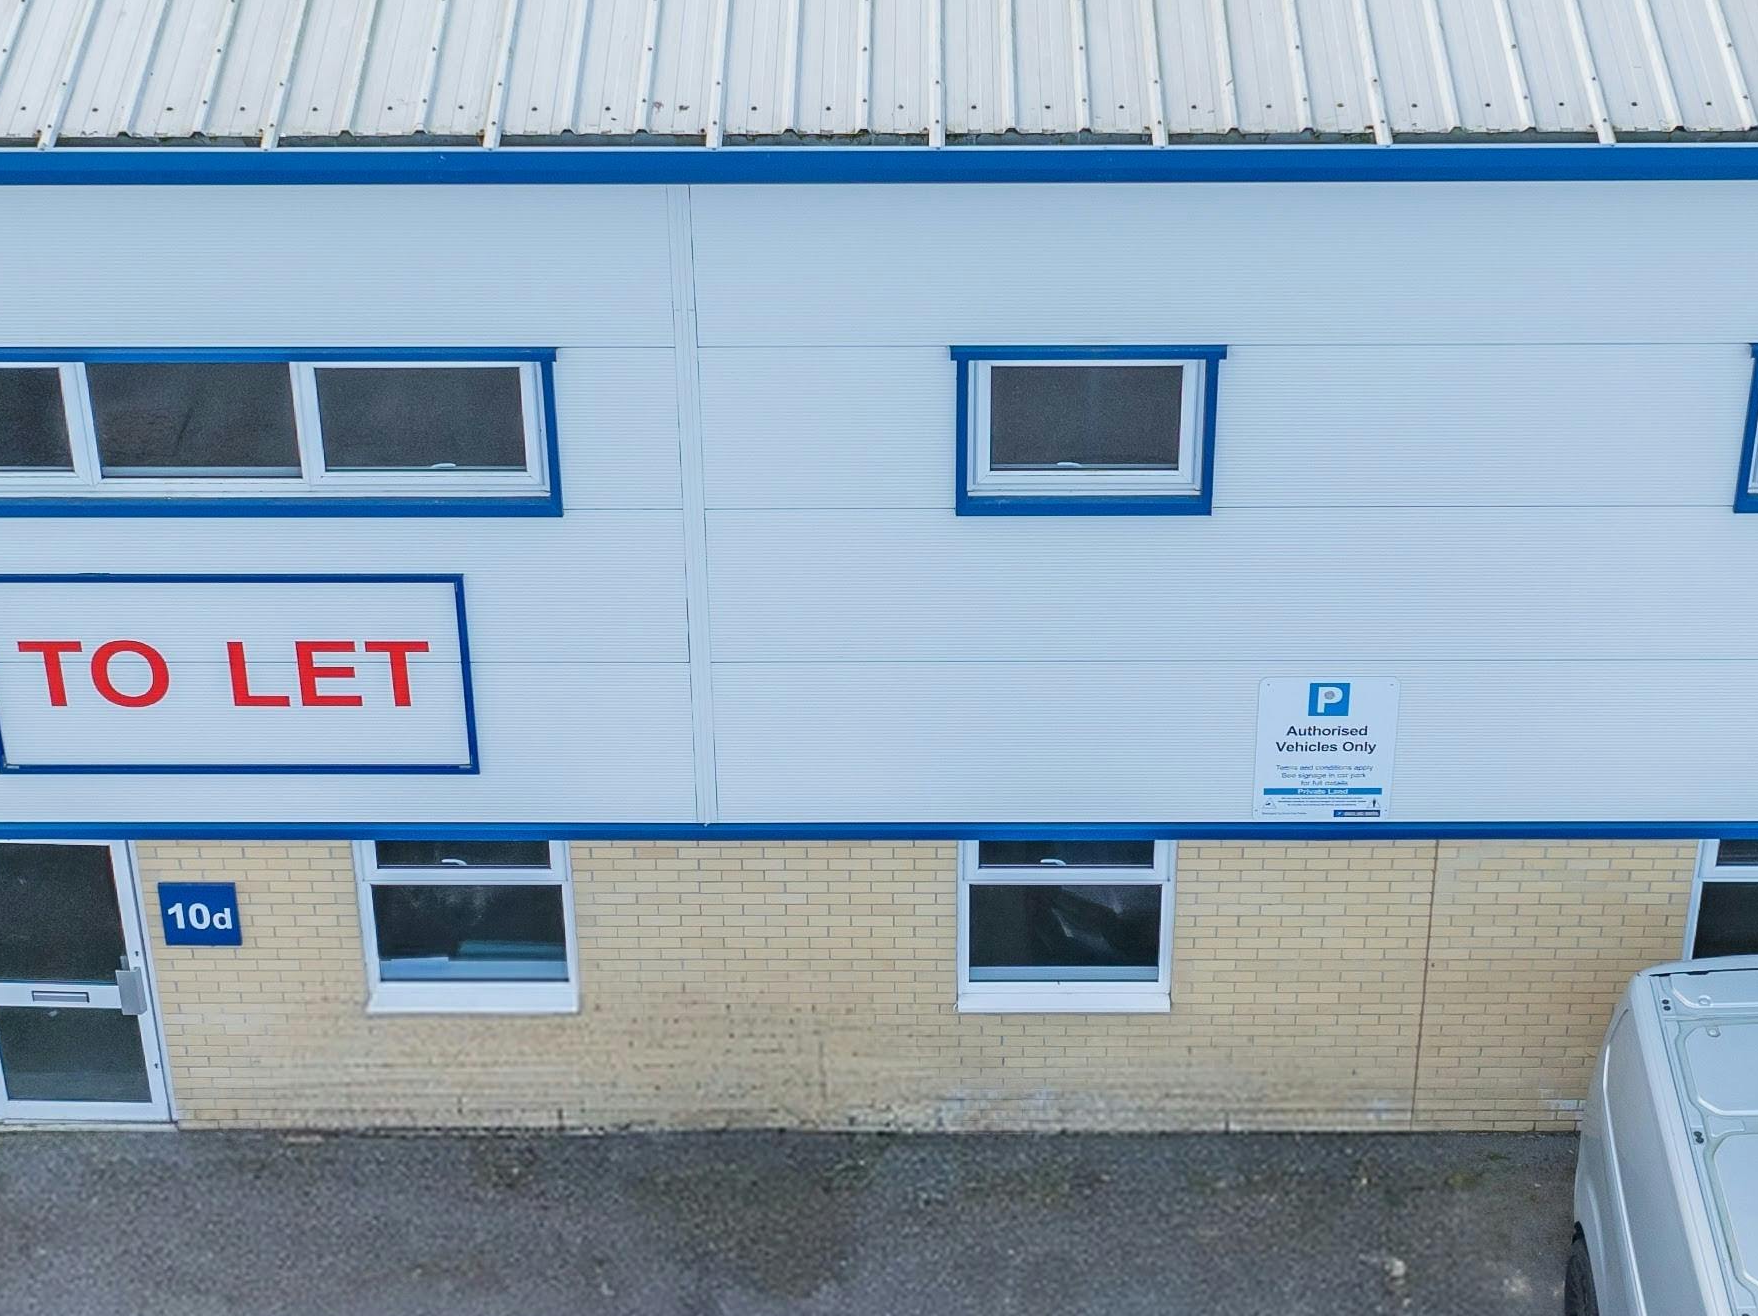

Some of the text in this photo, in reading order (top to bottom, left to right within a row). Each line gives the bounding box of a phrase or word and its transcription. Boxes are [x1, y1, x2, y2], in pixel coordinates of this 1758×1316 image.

[17, 639, 430, 708] TO LET
[1317, 686, 1344, 713] P
[1286, 725, 1369, 737] Authorised
[1275, 740, 1377, 755] Vehicles Only
[167, 902, 233, 930] 10d
